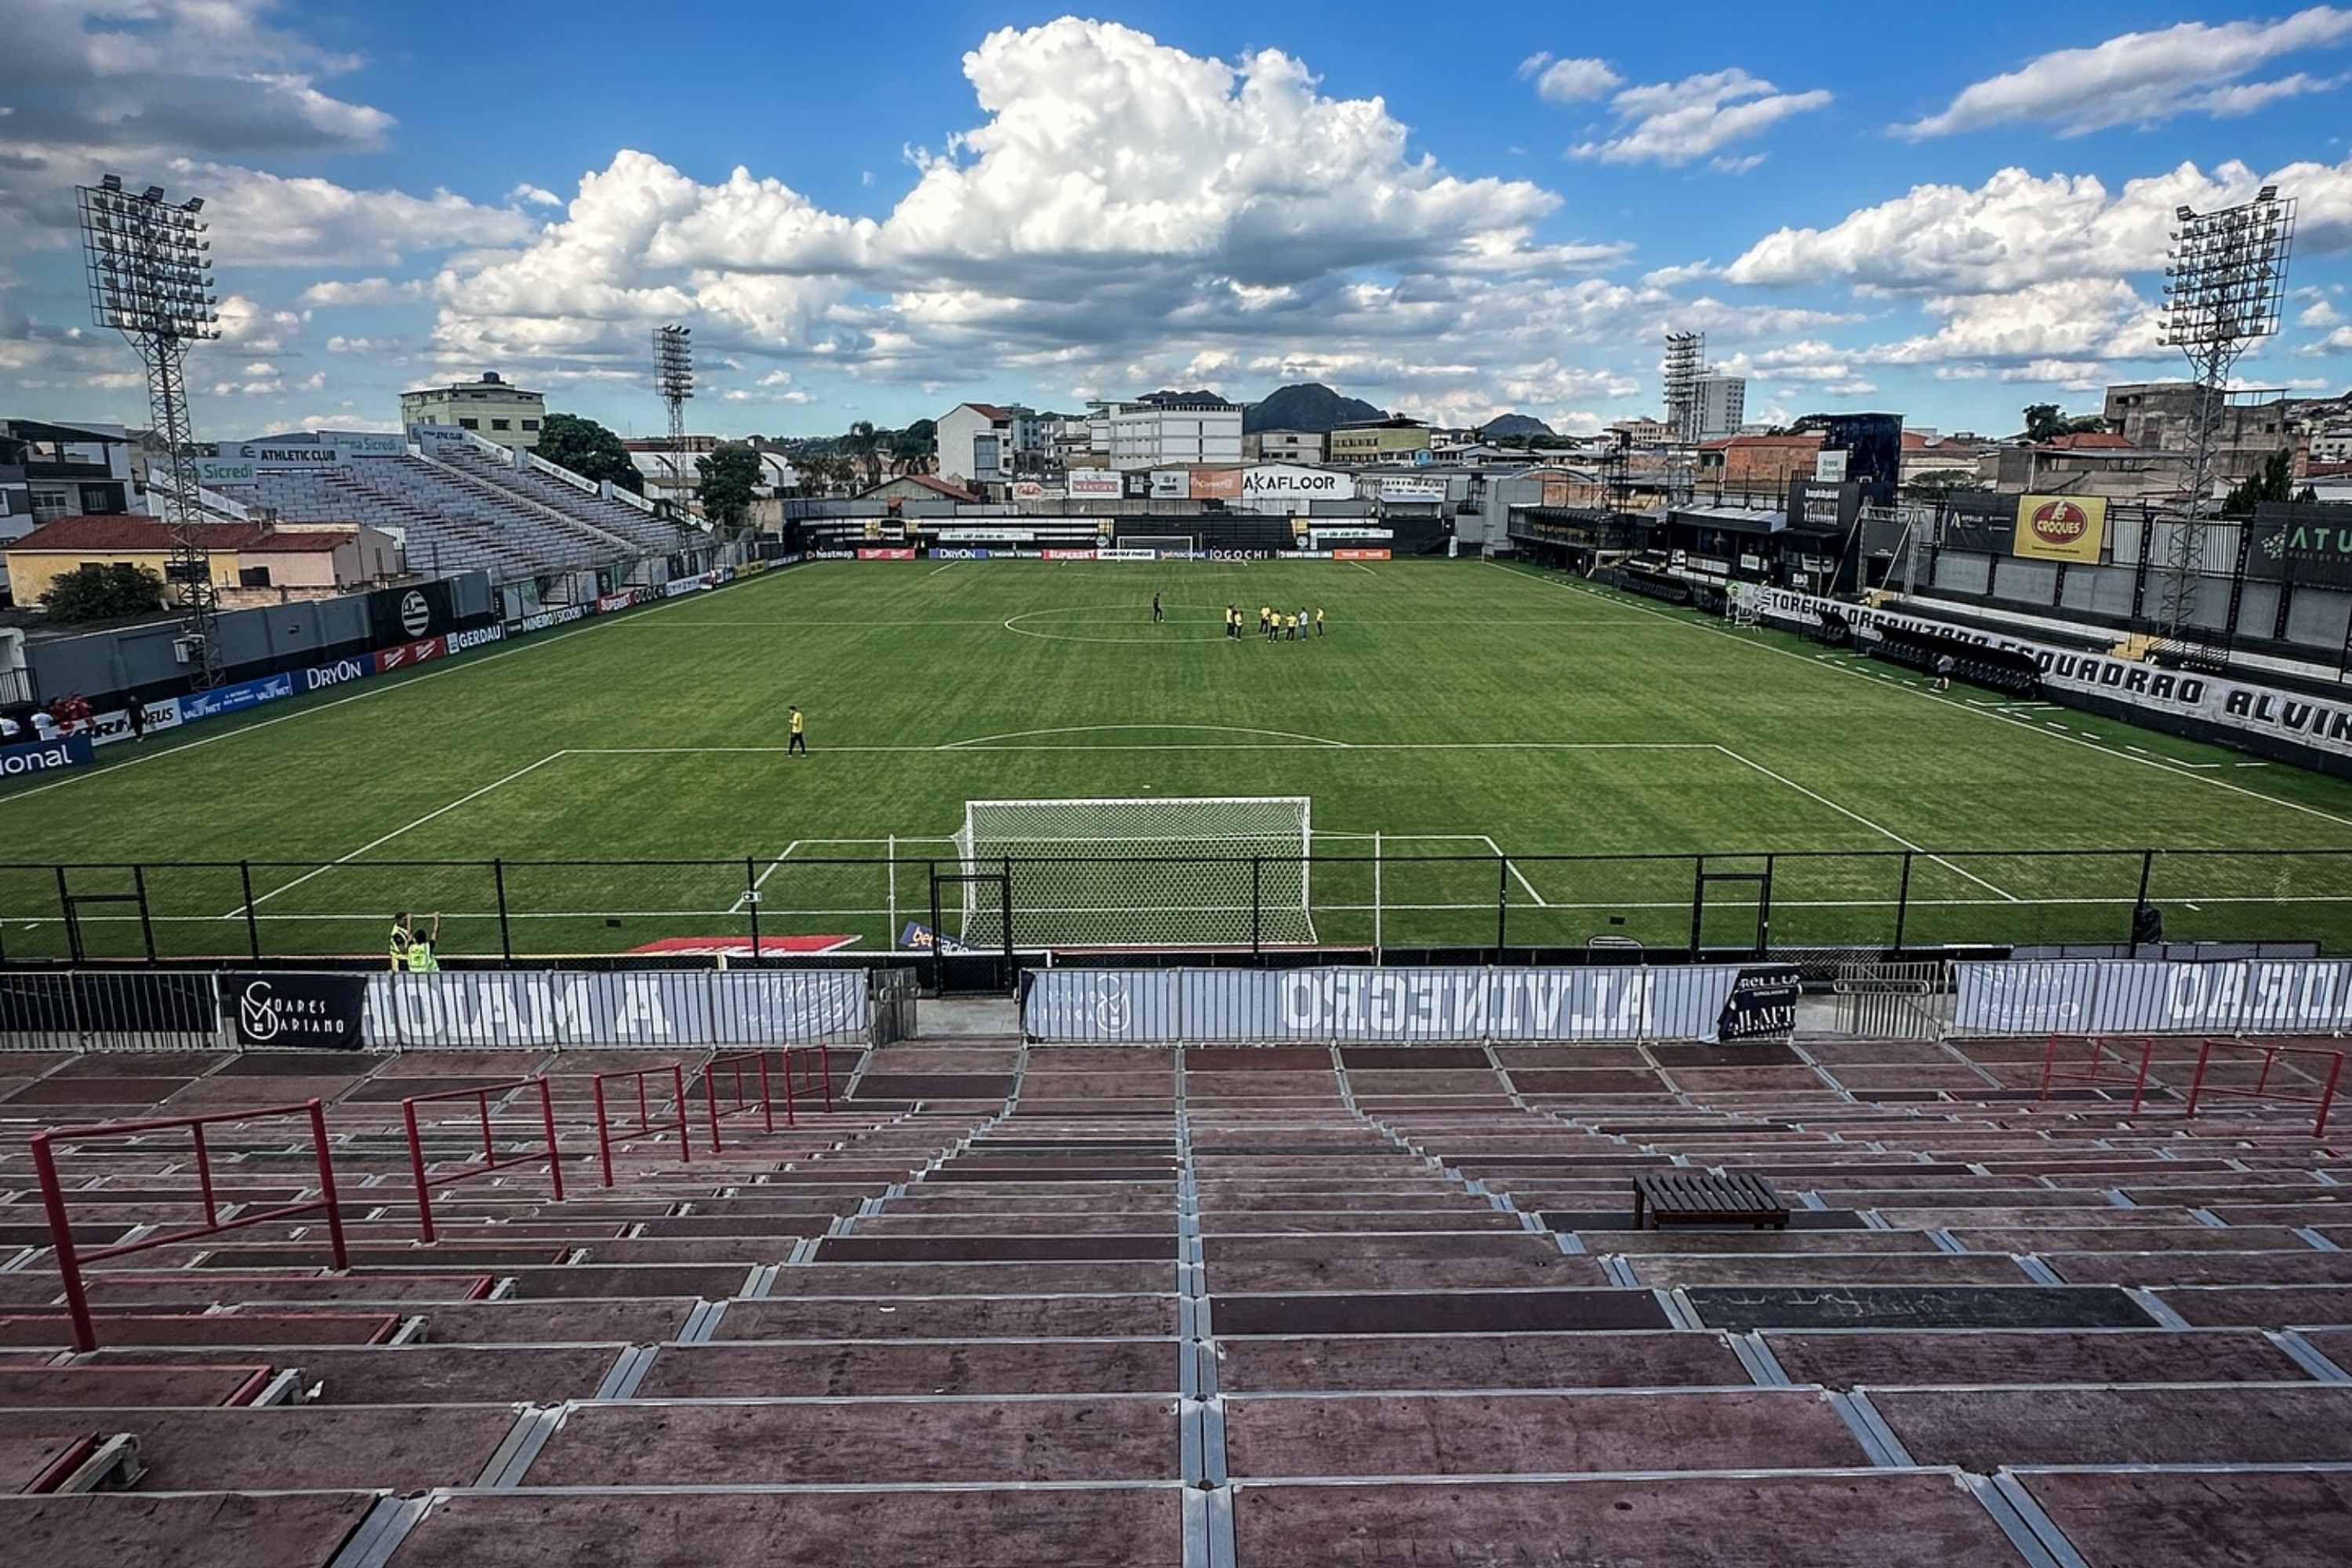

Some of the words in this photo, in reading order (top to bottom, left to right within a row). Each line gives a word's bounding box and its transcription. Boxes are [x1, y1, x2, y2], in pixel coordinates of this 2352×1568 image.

[364, 437, 396, 451] Sicredi
[261, 448, 310, 462] ATHLETIC
[311, 448, 336, 461] CLUB
[204, 463, 252, 479] Sicredi
[1243, 472, 1335, 493] AKAFLOOR
[2038, 521, 2081, 535] CROQUES
[459, 626, 500, 648] GERDAU
[2000, 641, 2205, 704] QUADRAO
